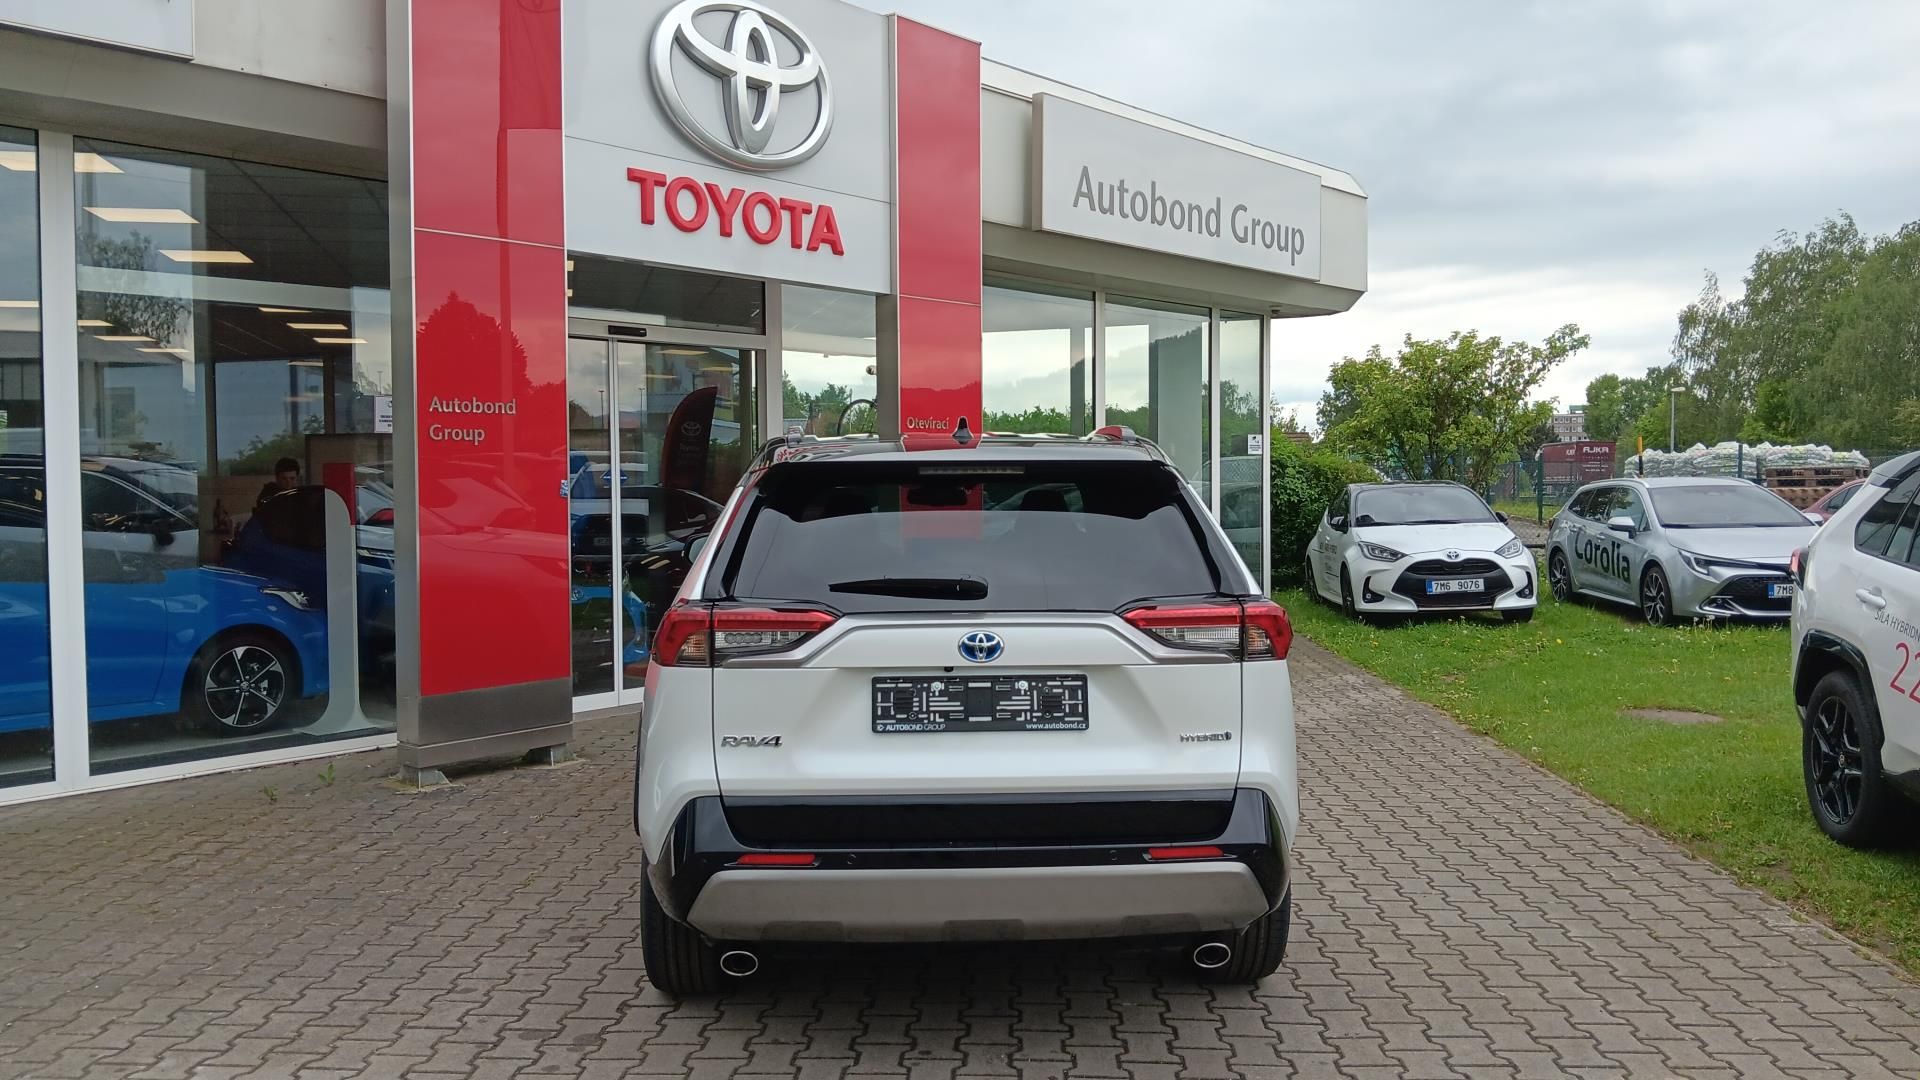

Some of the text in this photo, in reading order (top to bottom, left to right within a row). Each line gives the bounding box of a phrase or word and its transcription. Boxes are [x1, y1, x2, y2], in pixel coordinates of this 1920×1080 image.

[627, 168, 844, 256] TOYOTA
[1073, 166, 1305, 266] Autobond Group
[429, 396, 517, 414] Autobond
[429, 424, 485, 446] Group
[1434, 580, 1480, 591] 7M6 9076
[885, 723, 923, 731] AUTOBOND
[721, 735, 783, 748] RAV4
[1179, 732, 1225, 743] HYBRID
